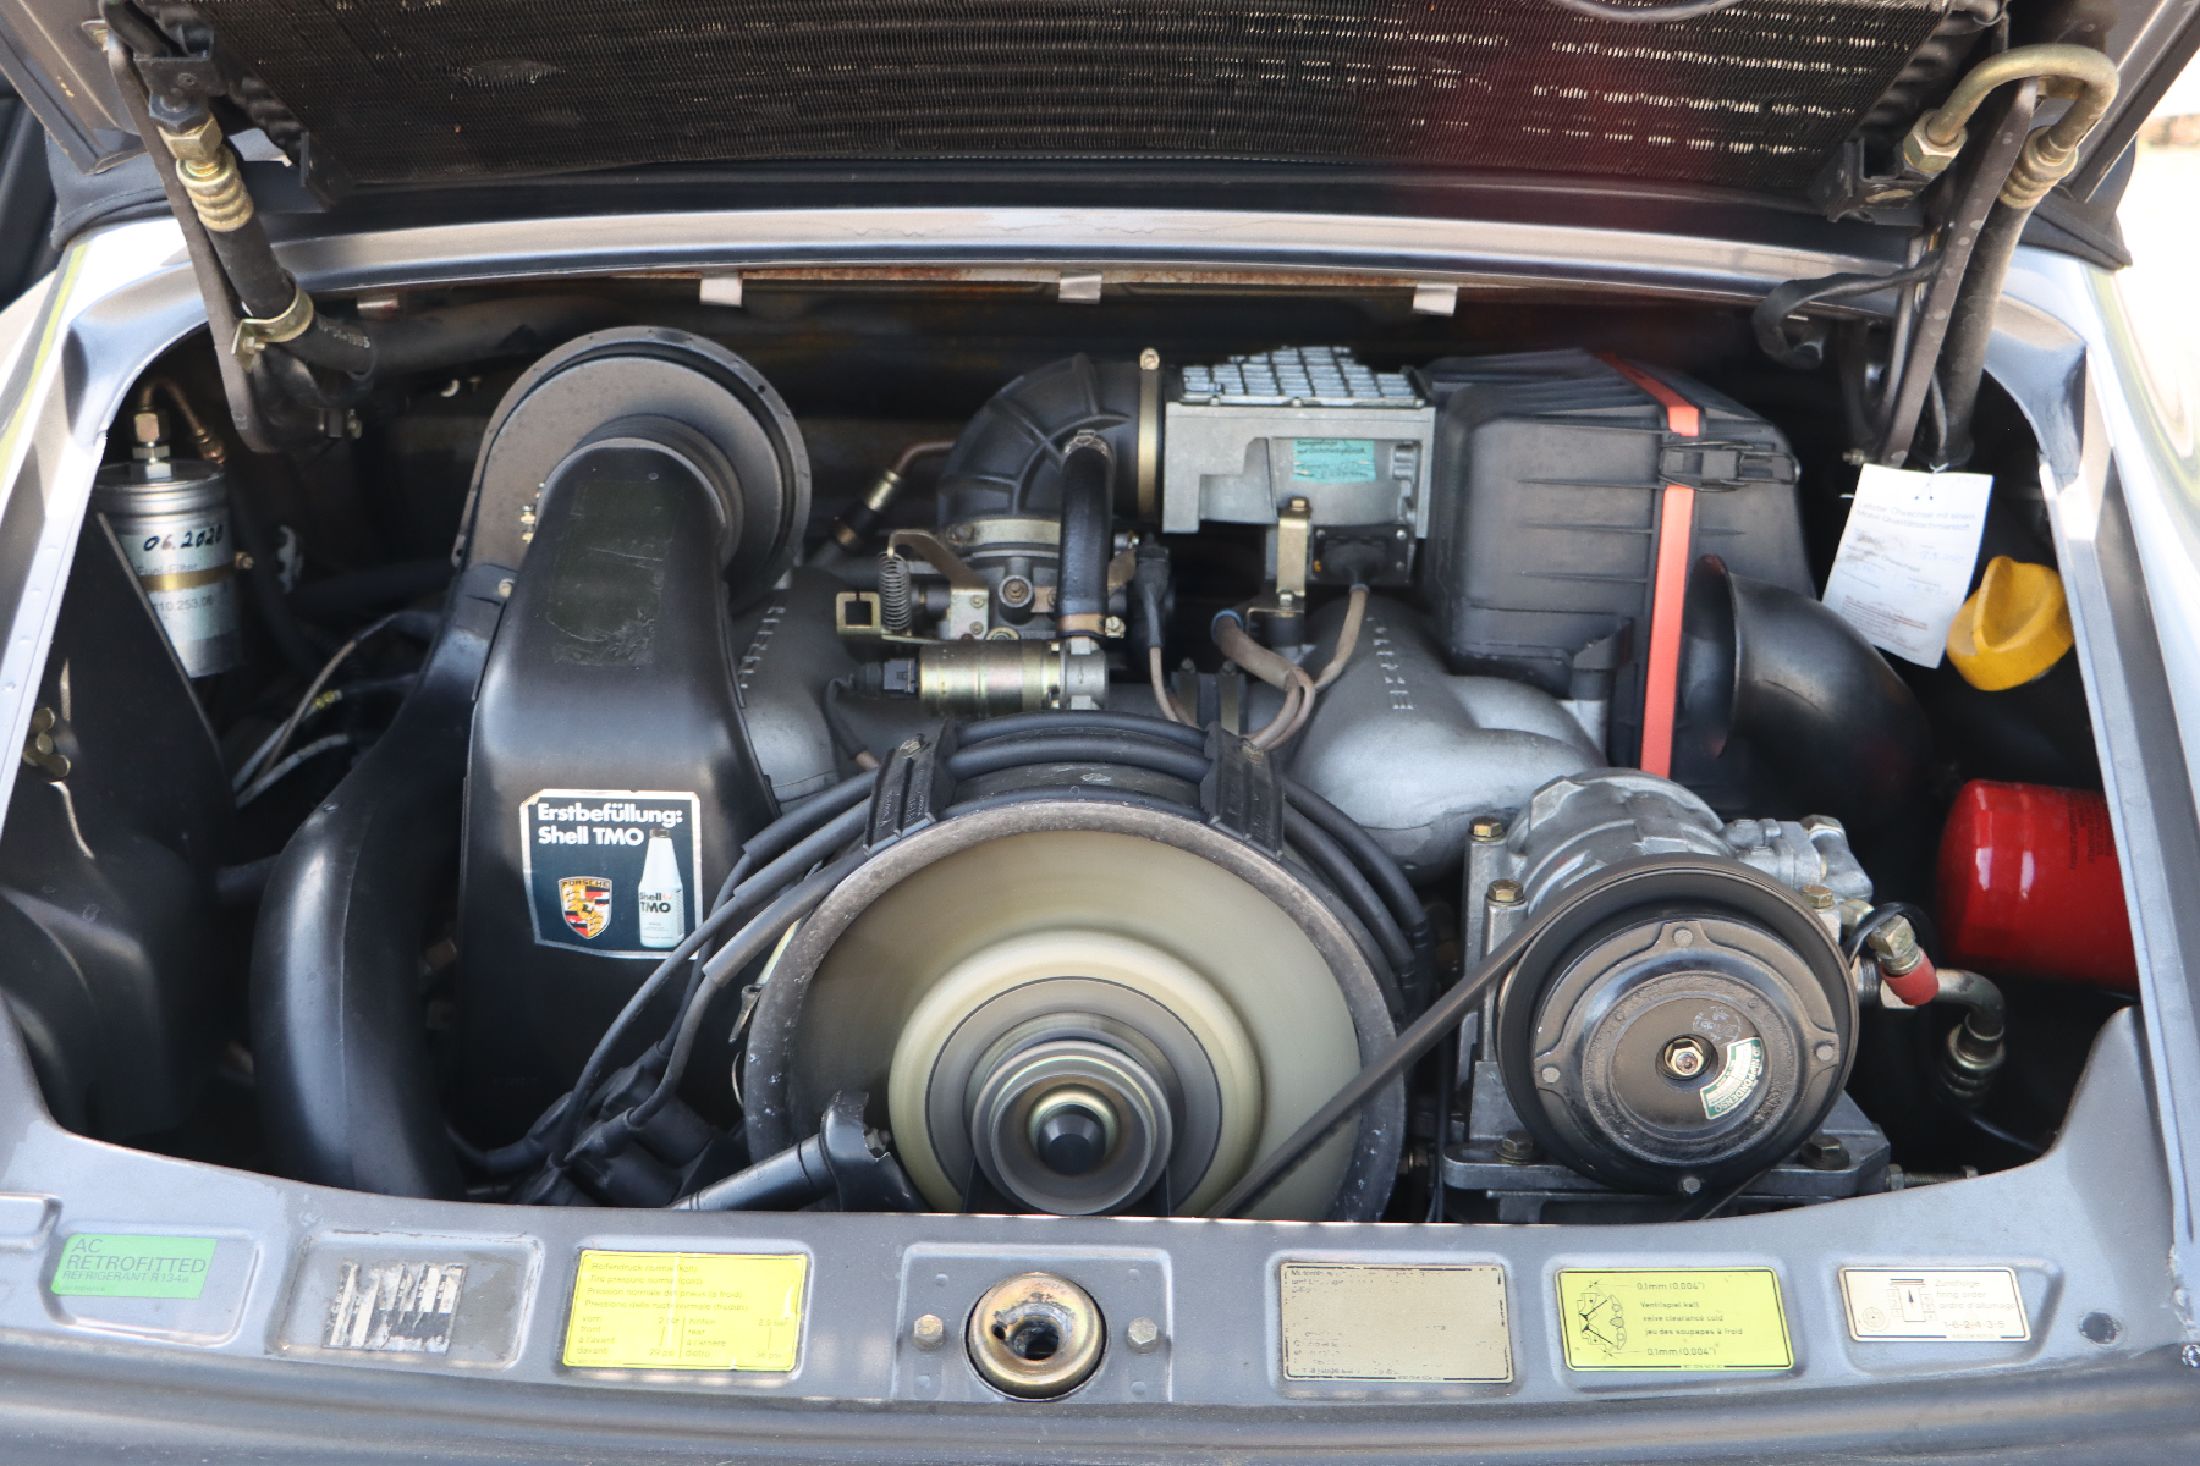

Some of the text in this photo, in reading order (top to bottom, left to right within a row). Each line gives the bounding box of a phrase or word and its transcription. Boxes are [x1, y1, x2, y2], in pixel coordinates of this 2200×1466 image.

[537, 803, 683, 827] Erstbefüllung:
[538, 825, 645, 846] Shell TMO
[561, 880, 608, 888] PORSCHE
[639, 892, 662, 901] Shell
[640, 902, 671, 914] TMO
[71, 1238, 104, 1253] AC
[66, 1254, 206, 1273] RETROFITTED
[62, 1270, 148, 1281] REFRIGERANT
